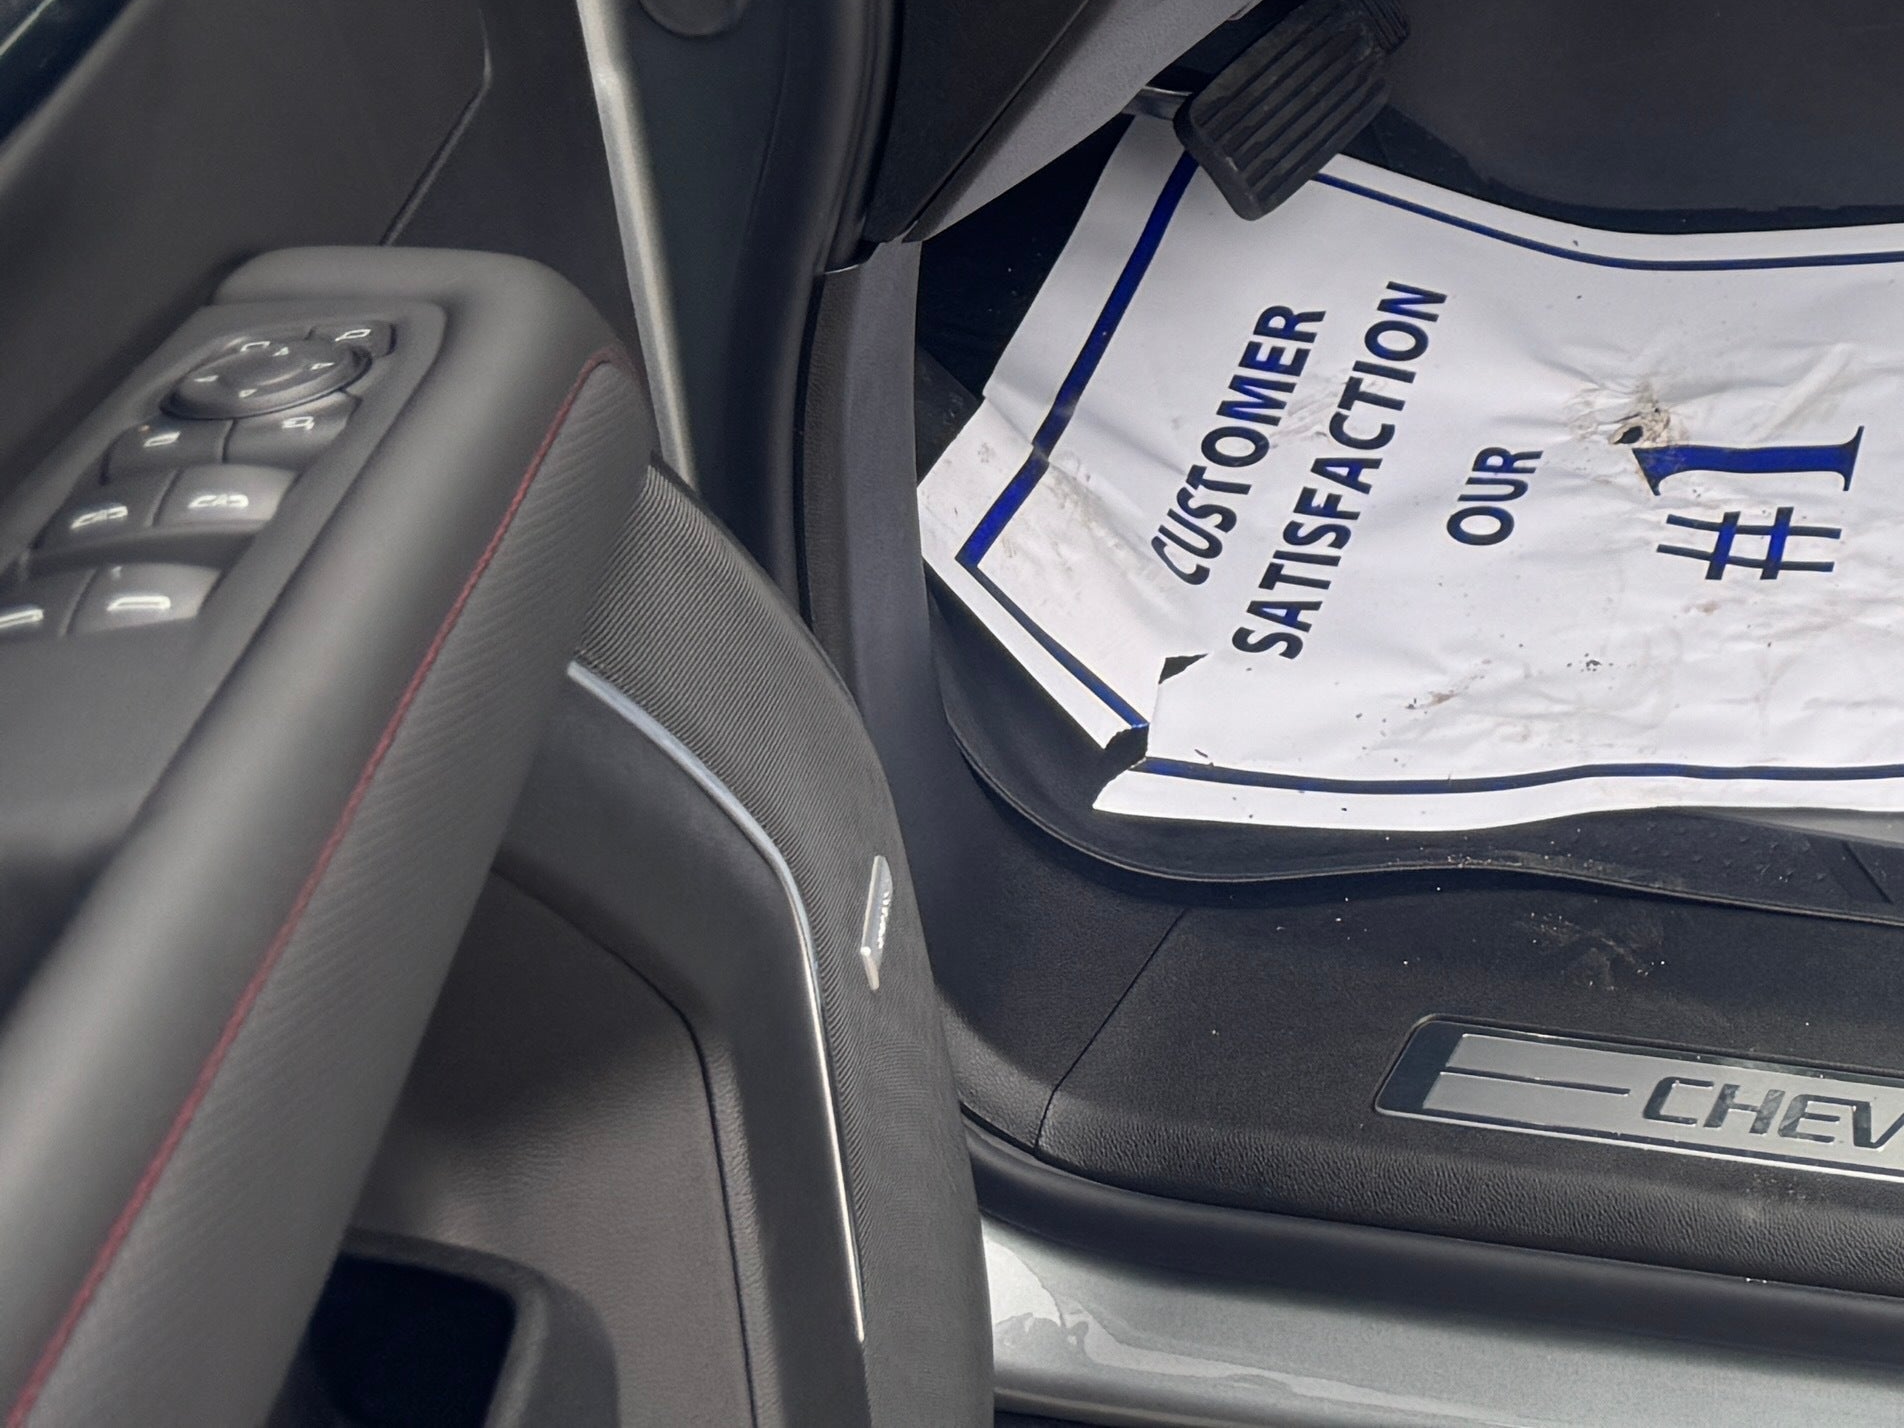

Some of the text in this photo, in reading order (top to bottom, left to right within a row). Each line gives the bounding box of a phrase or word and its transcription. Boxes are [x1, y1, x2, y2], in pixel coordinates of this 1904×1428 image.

[1150, 304, 1327, 586] CUSTOMER
[1231, 280, 1448, 660] SATISFACTION
[1446, 445, 1545, 546] OUR
[1632, 424, 1866, 581] #1
